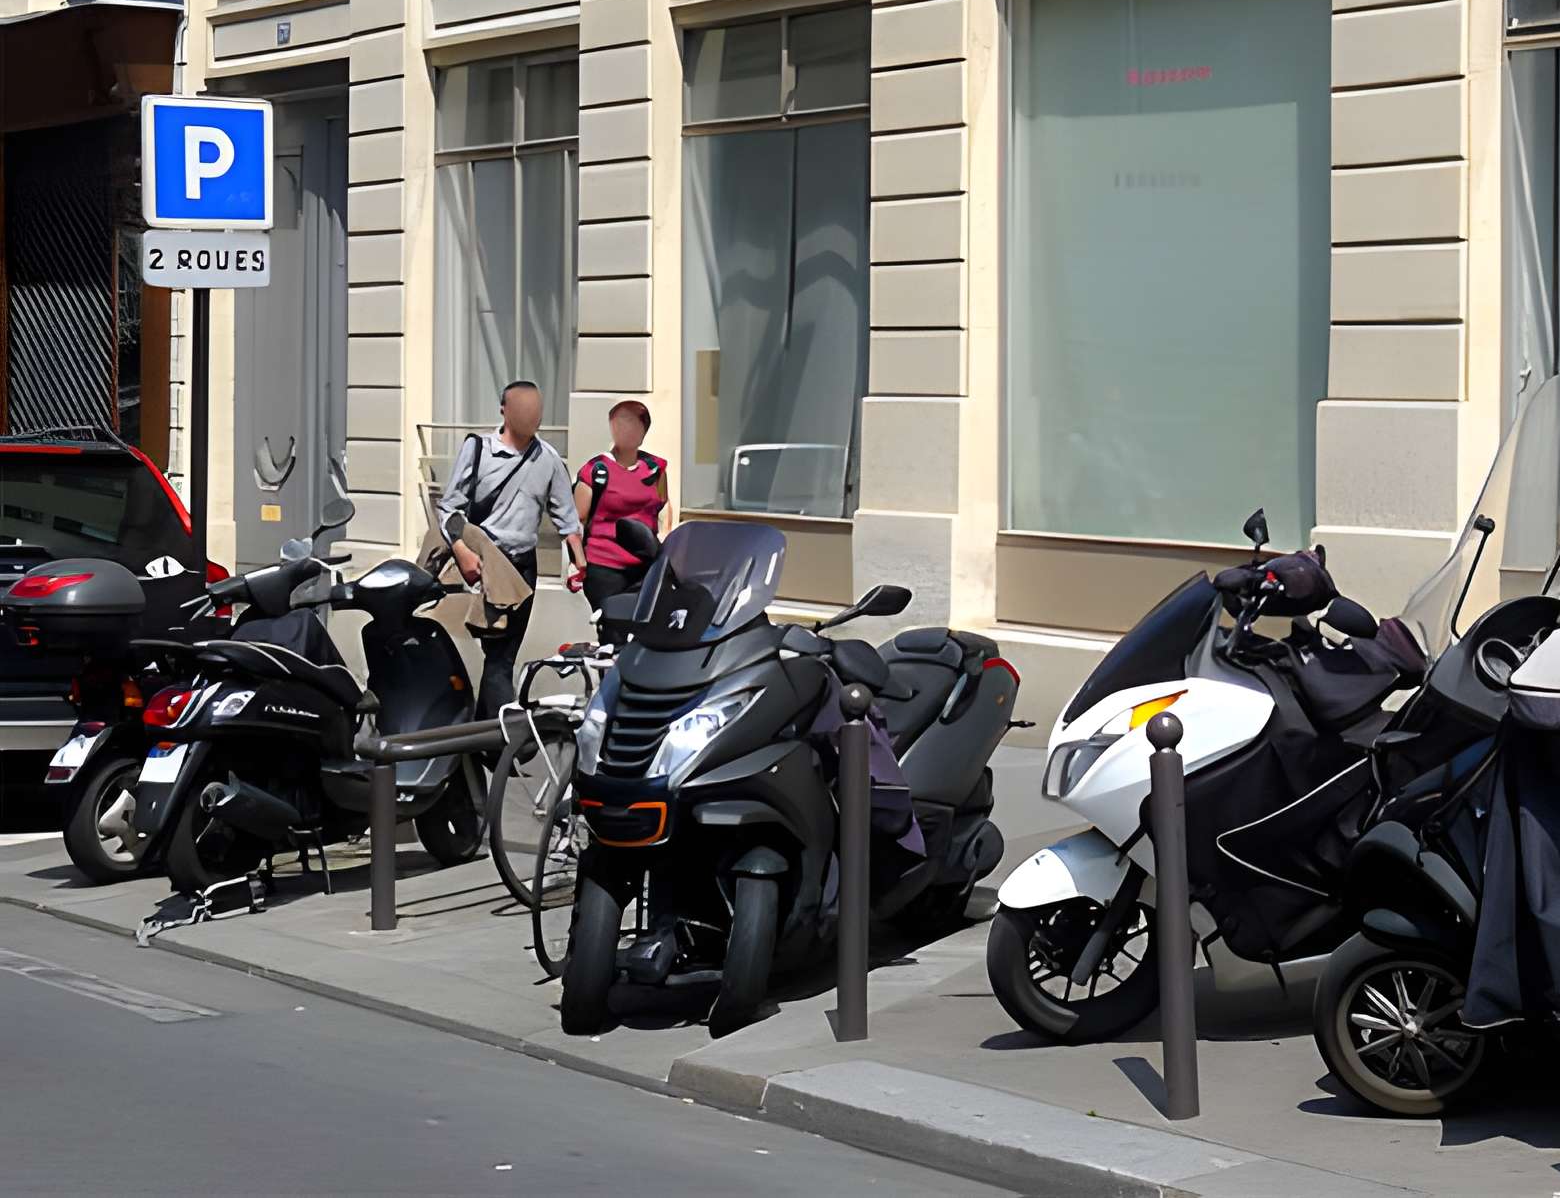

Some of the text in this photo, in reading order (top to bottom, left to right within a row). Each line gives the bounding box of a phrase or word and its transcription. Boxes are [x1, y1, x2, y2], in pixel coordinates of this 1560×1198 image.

[184, 125, 235, 200] P
[149, 248, 264, 271] 2 ROUES
